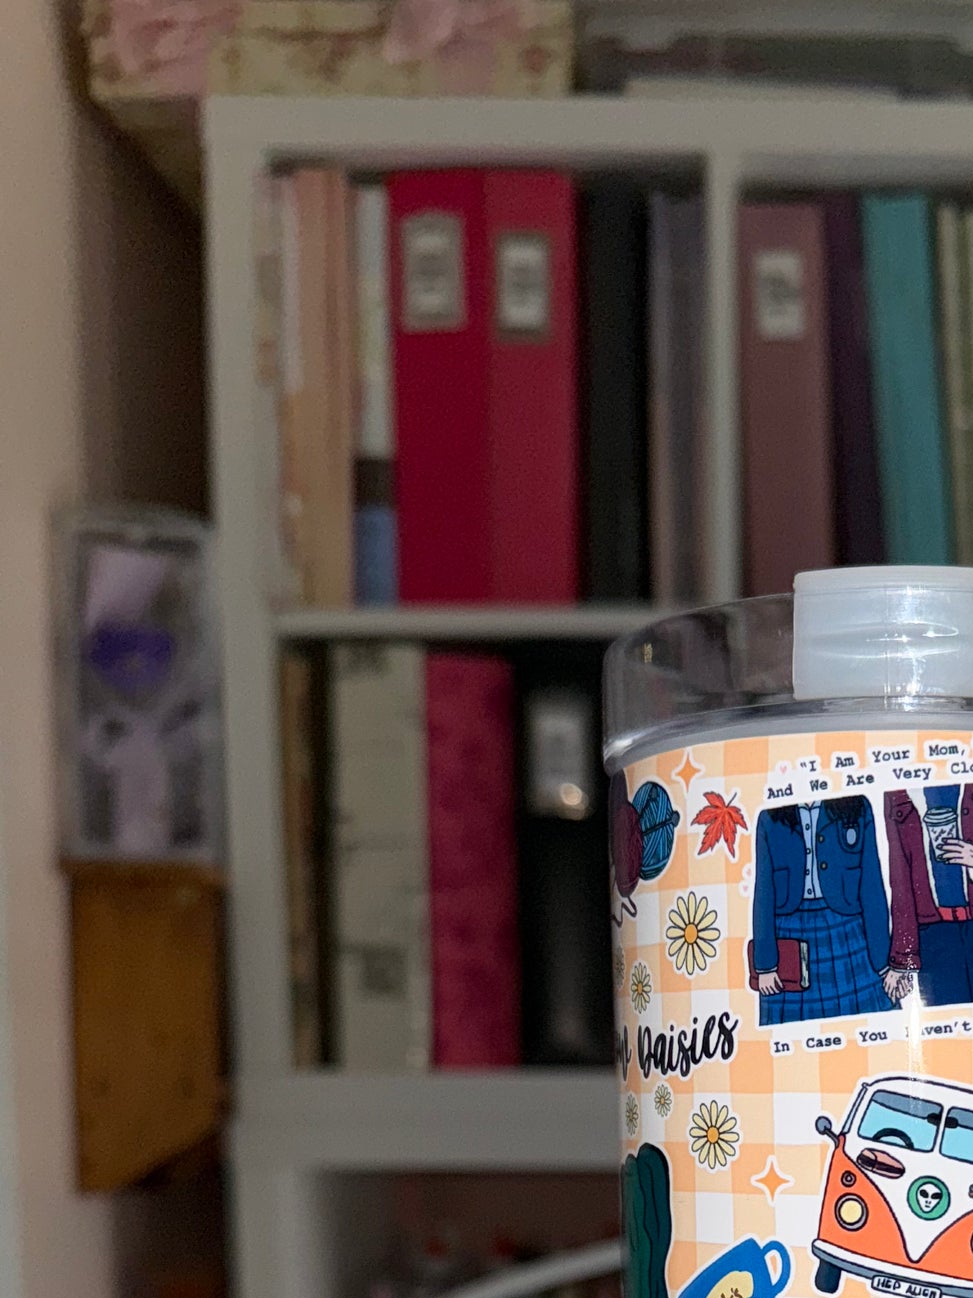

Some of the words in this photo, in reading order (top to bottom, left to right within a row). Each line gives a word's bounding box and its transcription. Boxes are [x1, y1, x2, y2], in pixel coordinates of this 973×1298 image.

[835, 756, 855, 768] Am
[872, 749, 910, 763] Your
[928, 744, 965, 757] Mom,
[767, 783, 794, 800] And
[809, 780, 828, 792] We
[846, 774, 875, 787] Are
[892, 767, 931, 780] Very
[637, 1011, 739, 1079] Daisies
[774, 1041, 790, 1053] In
[806, 1036, 842, 1049] Case
[859, 1030, 888, 1042] You
[905, 1020, 972, 1038] ven't
